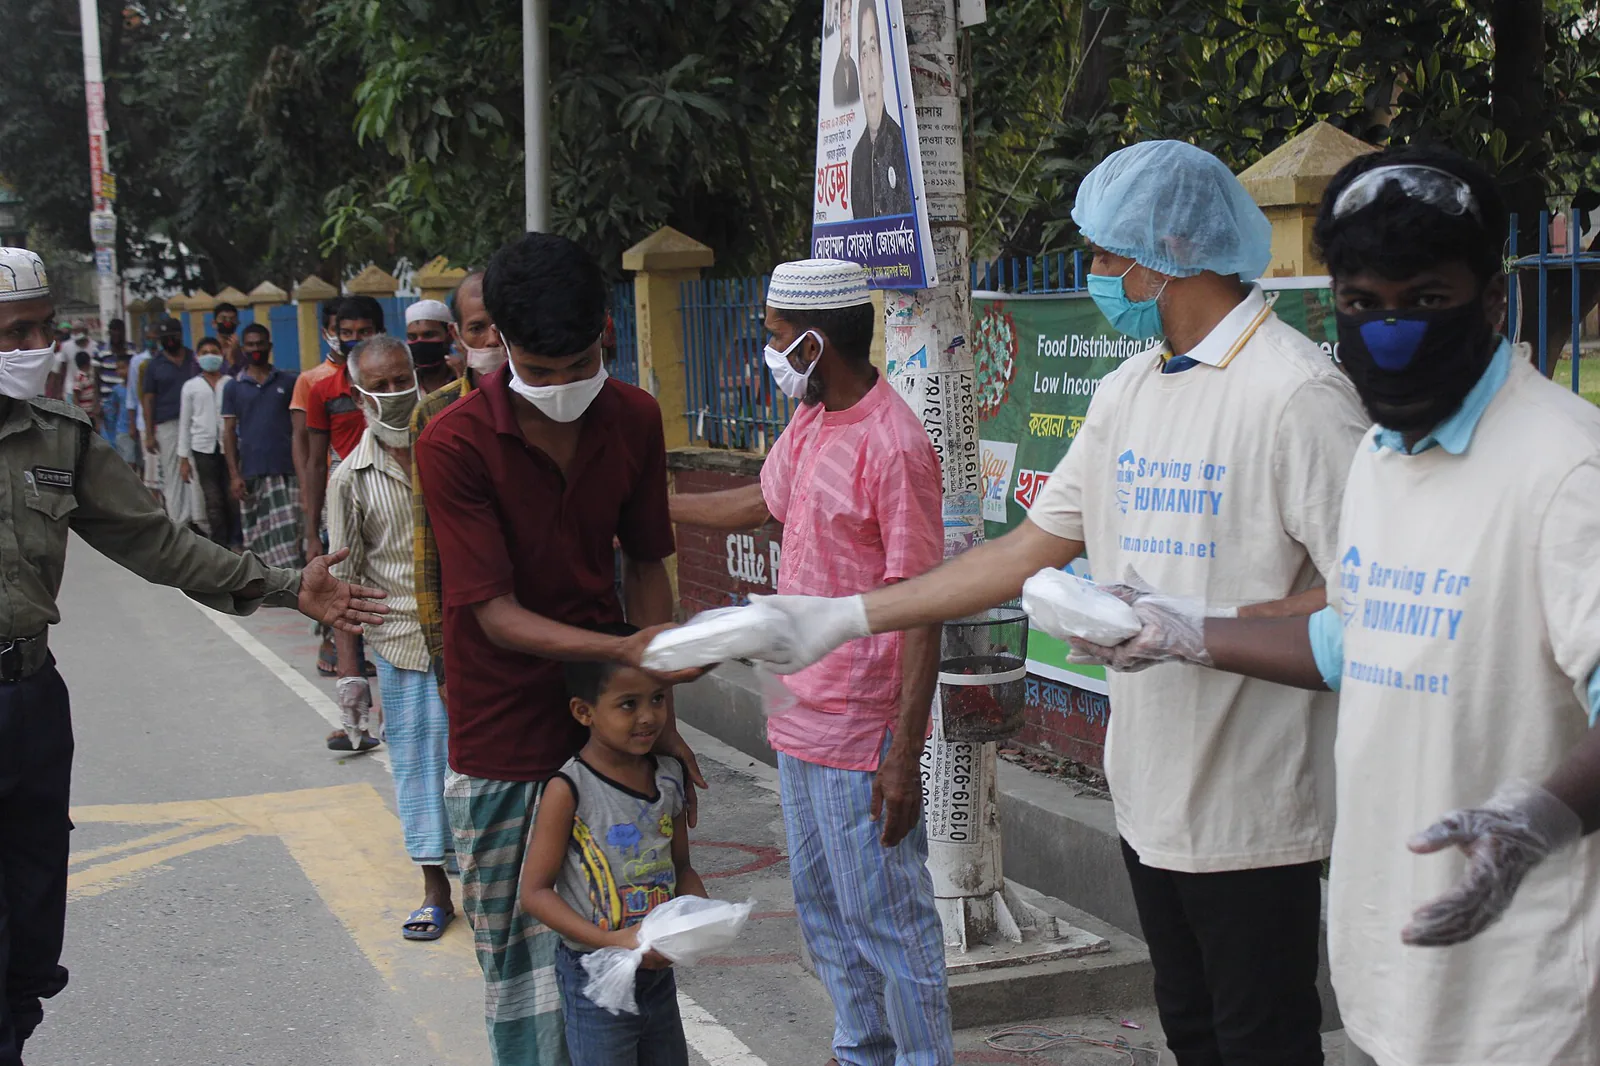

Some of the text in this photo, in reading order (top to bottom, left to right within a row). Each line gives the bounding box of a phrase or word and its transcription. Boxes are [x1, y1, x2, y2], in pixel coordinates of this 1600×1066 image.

[817, 160, 849, 210] শুভেচ্ছা
[814, 234, 845, 260] মোহাম্মদ
[846, 230, 875, 260] সোহাগ
[1037, 334, 1068, 357] Food
[1069, 334, 1142, 358] Distribution
[1034, 371, 1060, 393] Low
[1029, 413, 1066, 438] করোনা
[1134, 486, 1223, 516] HUMANITY
[726, 533, 768, 585] Elite
[1368, 562, 1426, 596] Serving
[1432, 568, 1471, 596] For
[1362, 598, 1463, 640] HUMANITY
[949, 742, 973, 841] 01919-9233
